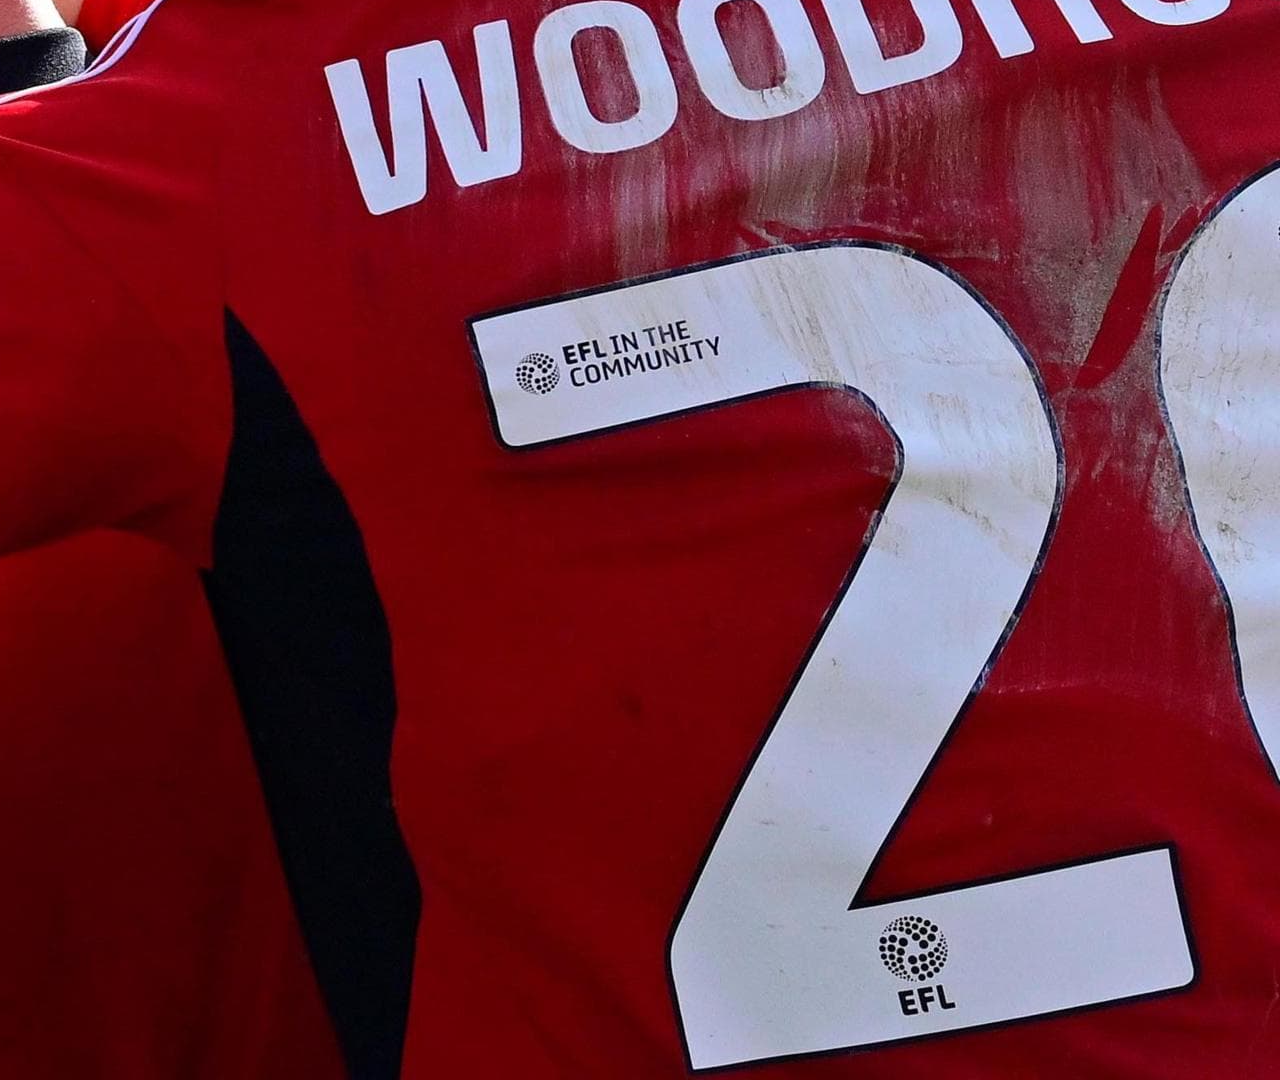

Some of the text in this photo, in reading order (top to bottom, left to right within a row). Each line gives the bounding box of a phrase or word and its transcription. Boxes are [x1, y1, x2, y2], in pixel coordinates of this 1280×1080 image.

[562, 320, 691, 365] EFL IN THE
[570, 336, 720, 388] COMMUNITY
[897, 984, 956, 1016] EFL
